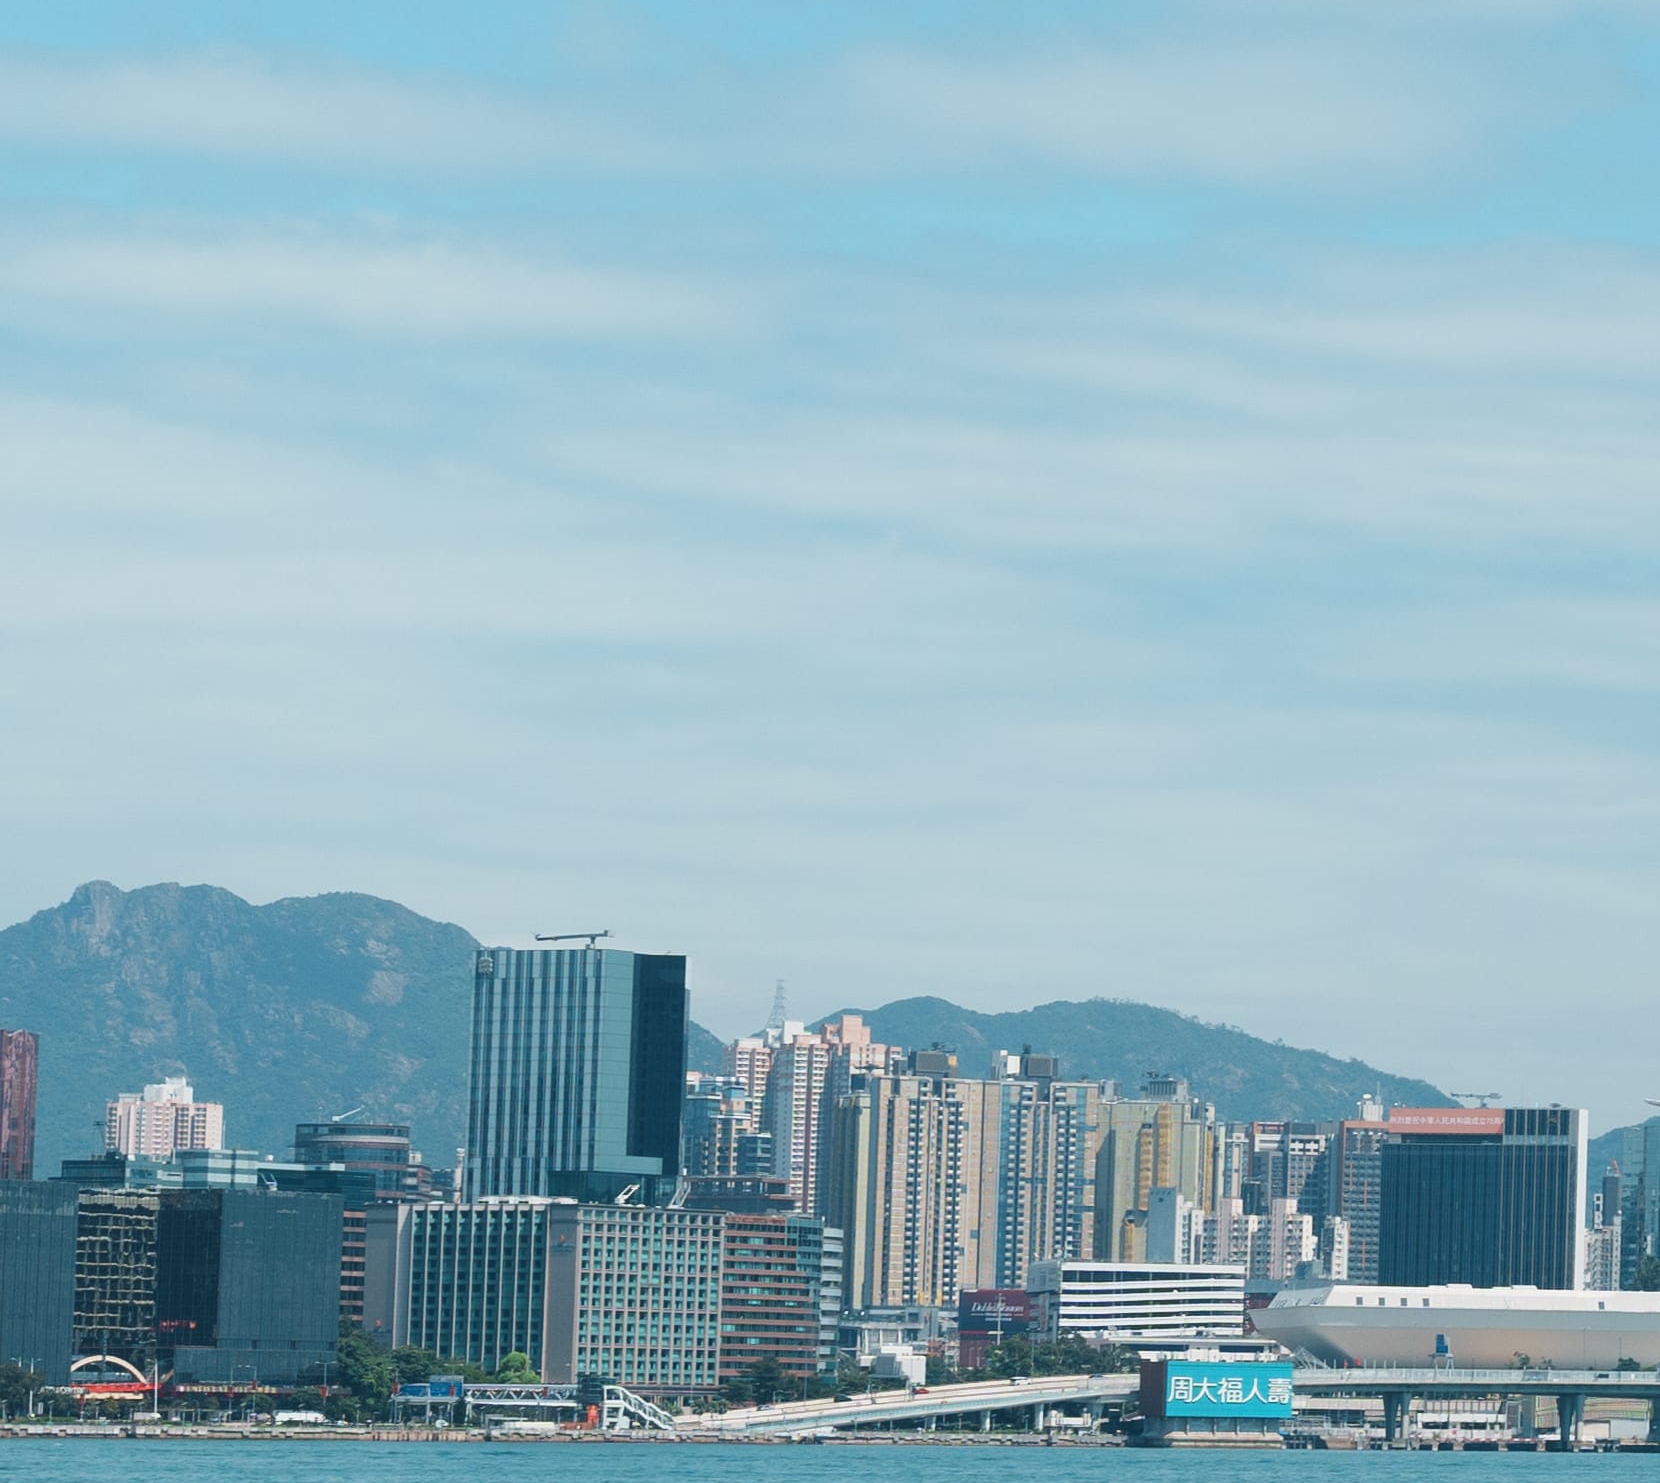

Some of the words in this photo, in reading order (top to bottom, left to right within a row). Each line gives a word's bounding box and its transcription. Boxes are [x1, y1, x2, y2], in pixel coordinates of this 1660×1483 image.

[1167, 1376, 1293, 1404] 周大福人壽
